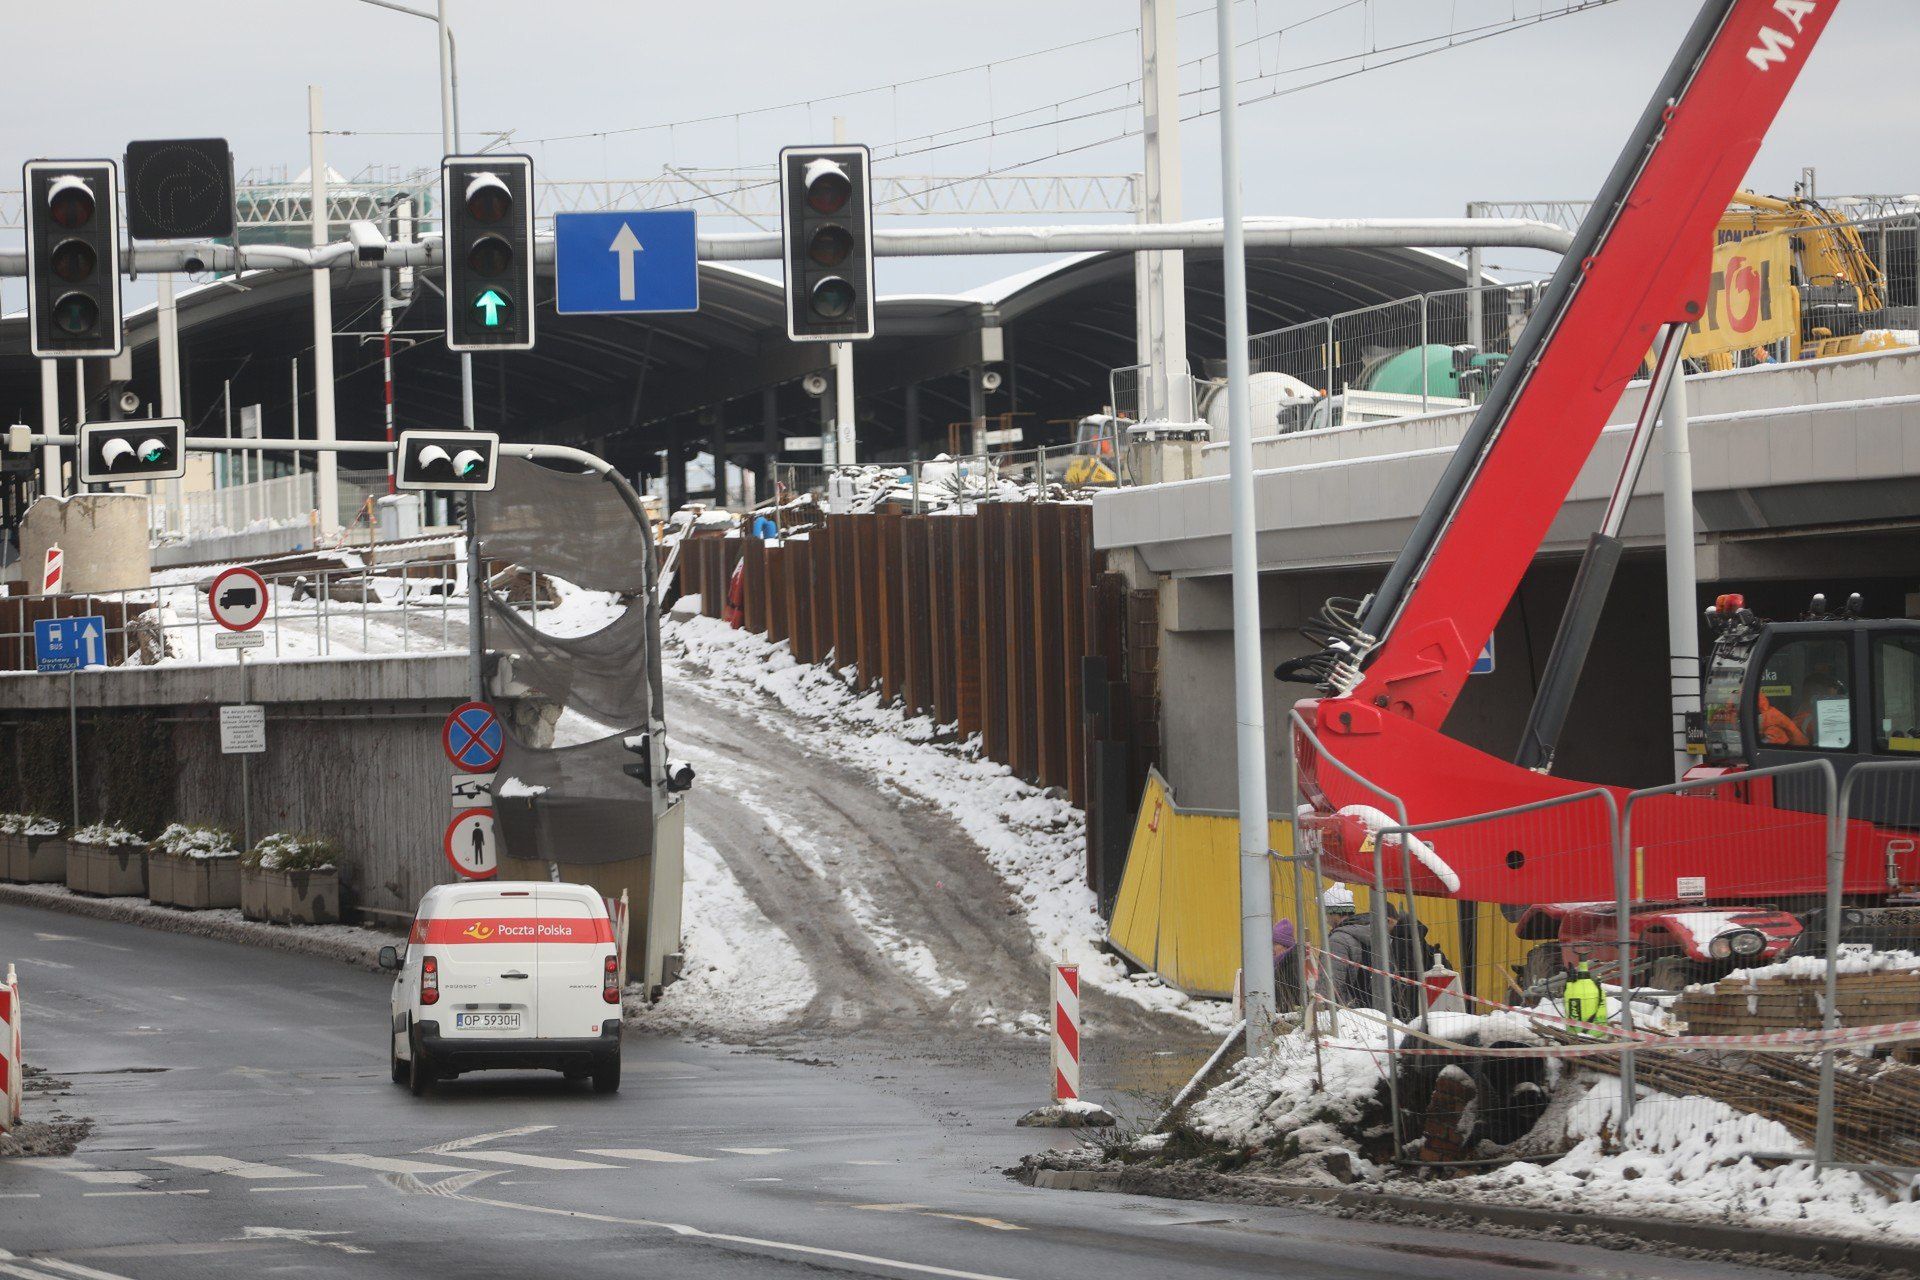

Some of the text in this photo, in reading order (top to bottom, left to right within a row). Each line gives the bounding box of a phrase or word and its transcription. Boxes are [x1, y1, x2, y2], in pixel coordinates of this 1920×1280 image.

[1718, 229, 1768, 245] KOMA
[498, 924, 572, 936] Poczta Polska
[464, 1015, 518, 1026] OP 5930H
